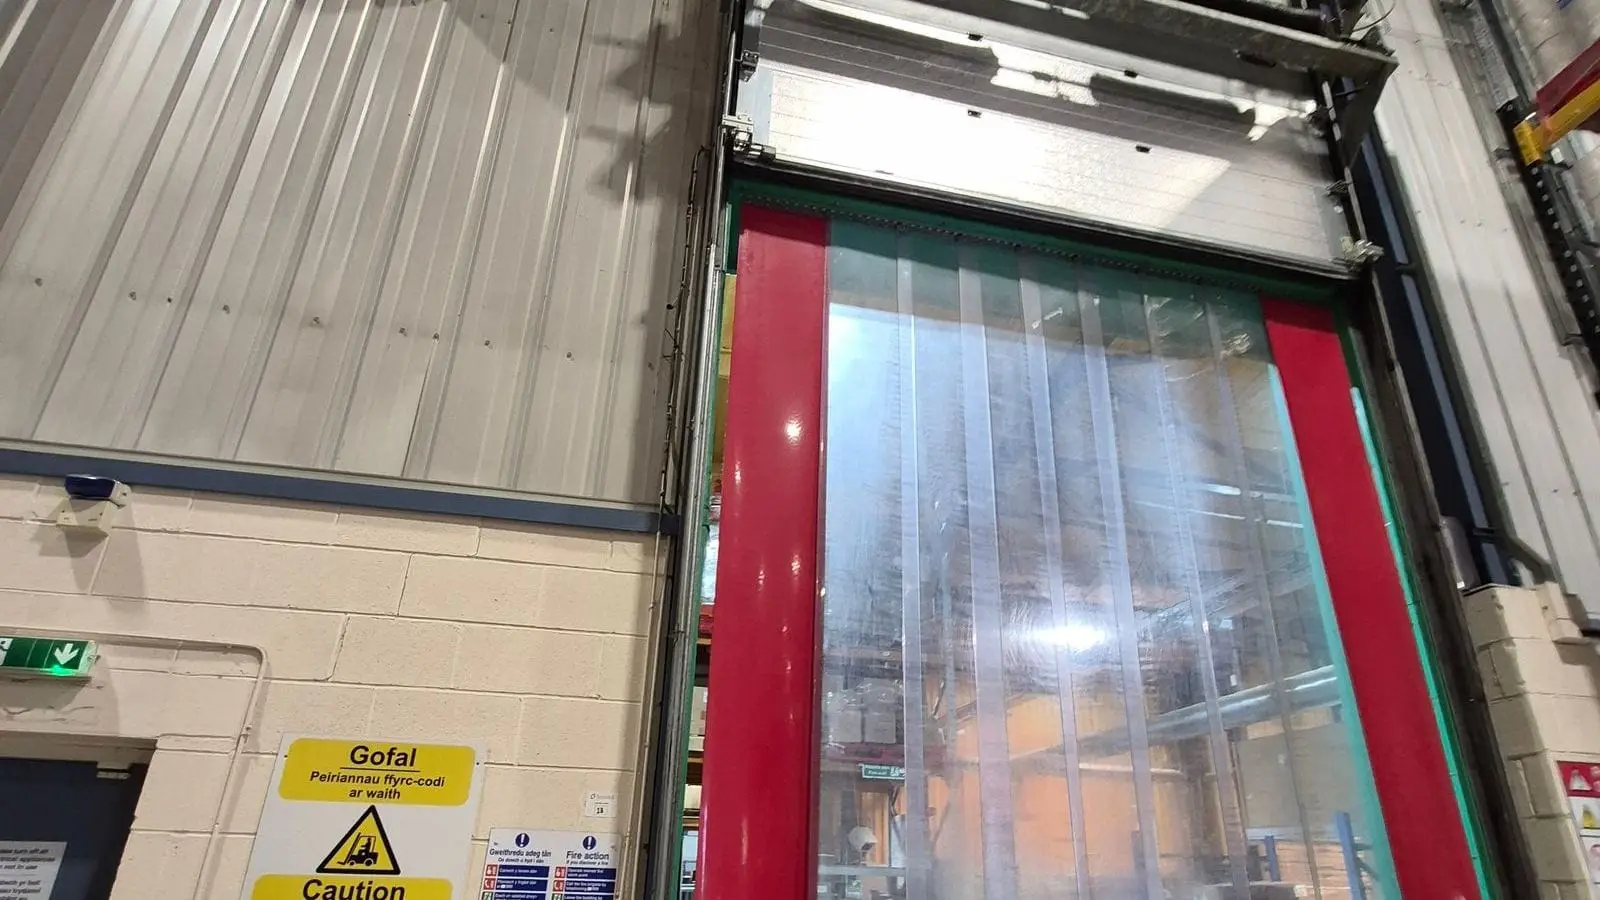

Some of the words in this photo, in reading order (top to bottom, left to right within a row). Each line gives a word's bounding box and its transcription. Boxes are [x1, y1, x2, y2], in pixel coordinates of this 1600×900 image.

[349, 745, 417, 767] Gofal
[309, 771, 380, 785] Peiriannau
[383, 774, 446, 788] ffyrc-codi
[349, 788, 364, 798] ar
[366, 788, 402, 799] waith
[489, 848, 524, 857] Gweithredu
[525, 850, 541, 858] adeg
[566, 850, 583, 860] Fire
[584, 852, 610, 860] action
[302, 878, 406, 900] Caution
